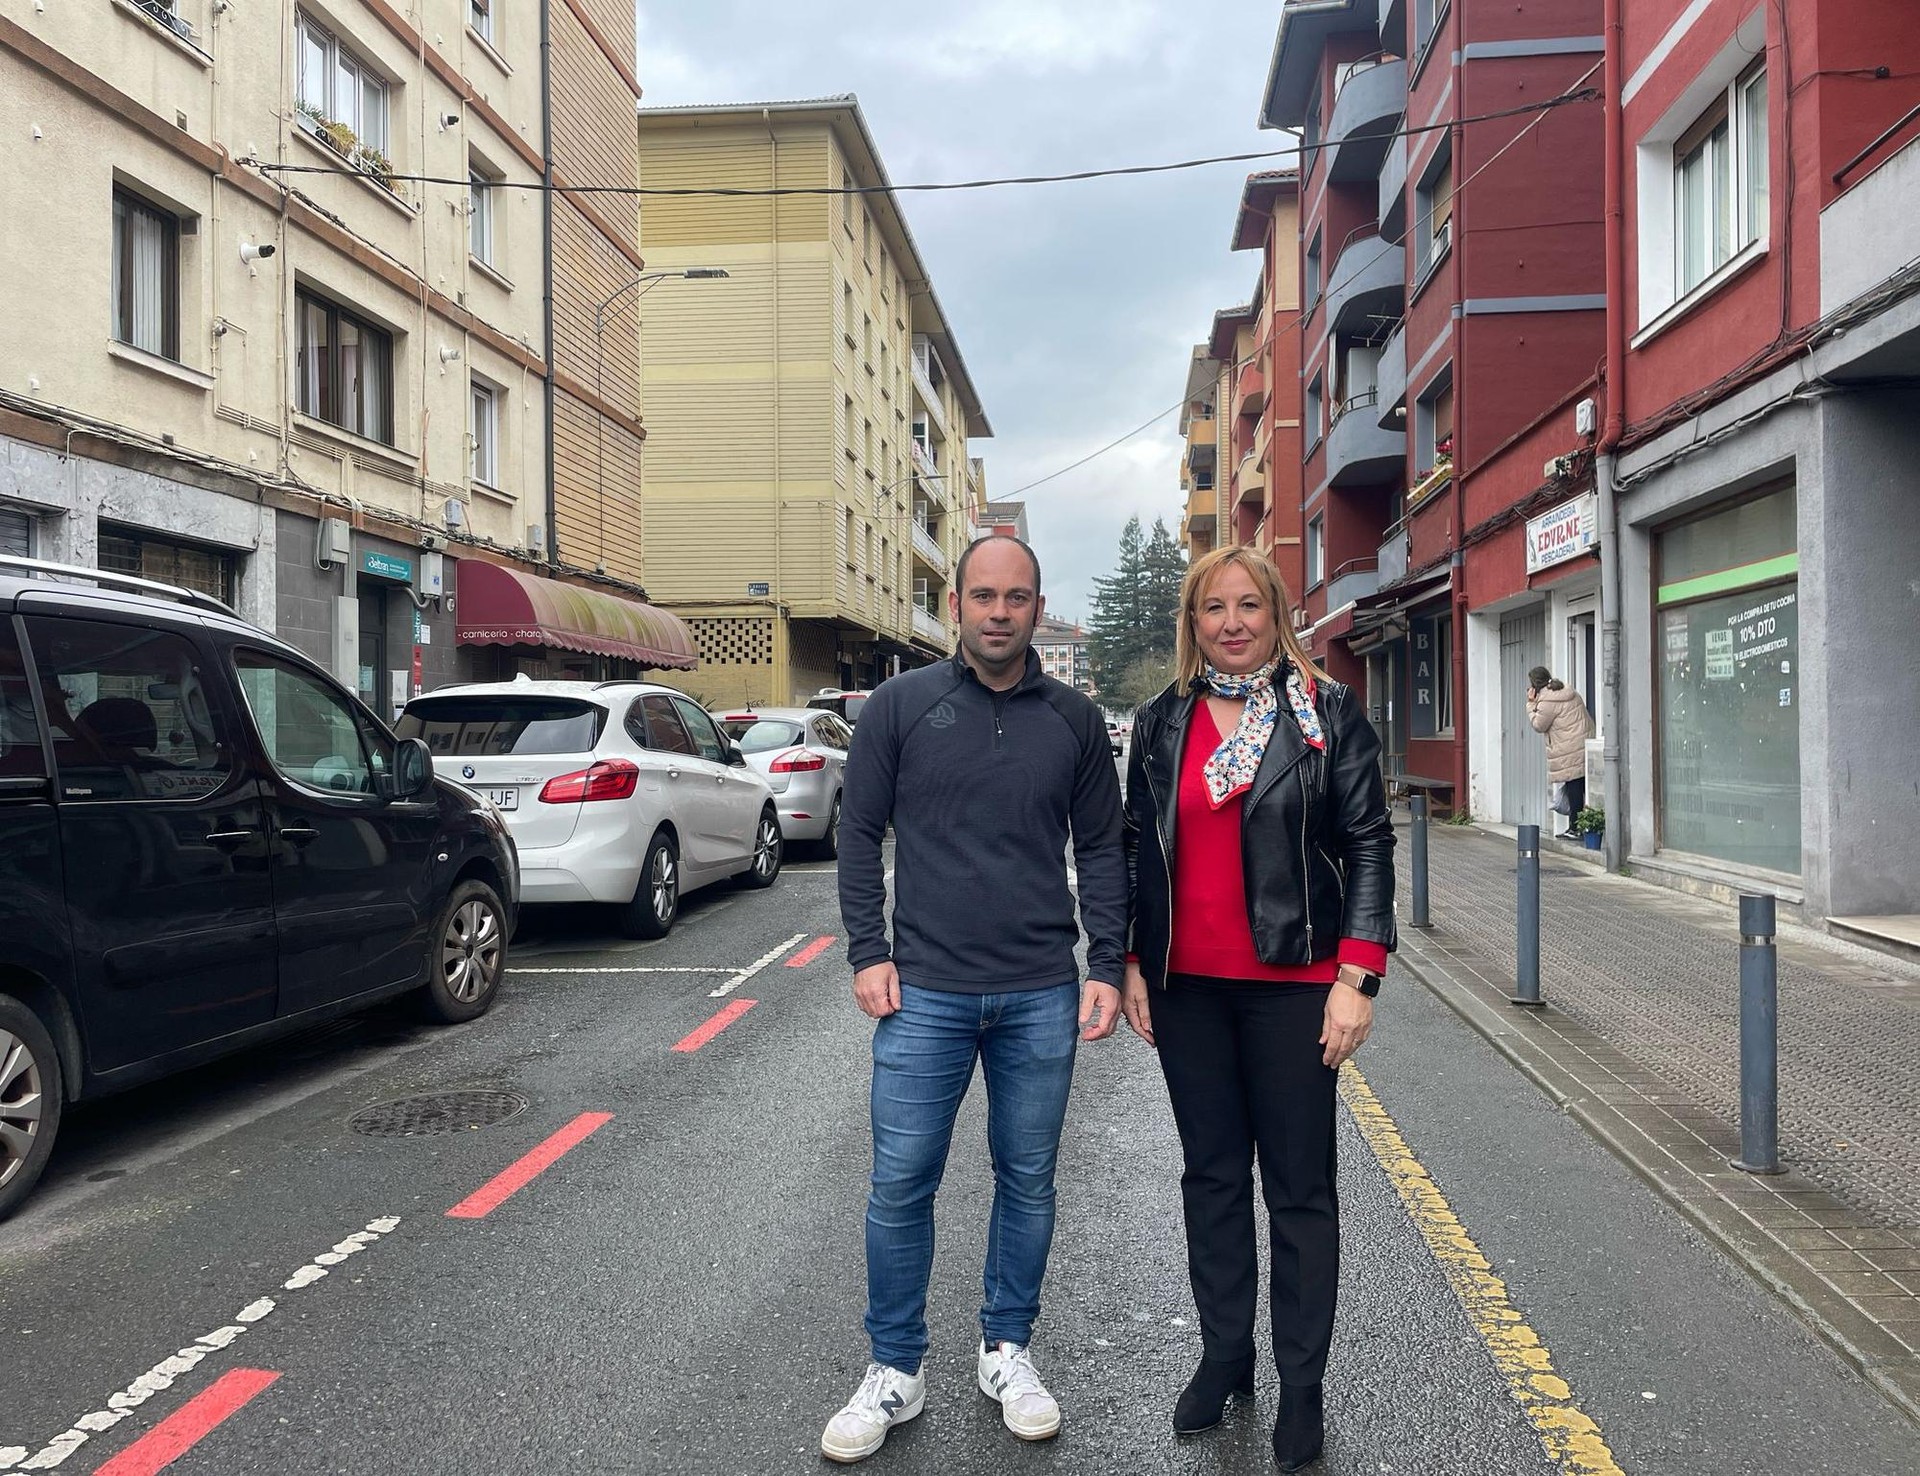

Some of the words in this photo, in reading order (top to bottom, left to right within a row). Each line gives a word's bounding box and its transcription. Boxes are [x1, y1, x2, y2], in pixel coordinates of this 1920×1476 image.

[1744, 605, 1763, 620] COMPRA
[1763, 602, 1770, 613] DE
[1776, 593, 1796, 608] COCINA
[1740, 624, 1756, 643] 10%
[1757, 616, 1776, 638] DTO
[1416, 633, 1430, 705] BAR
[880, 1390, 905, 1420] N
